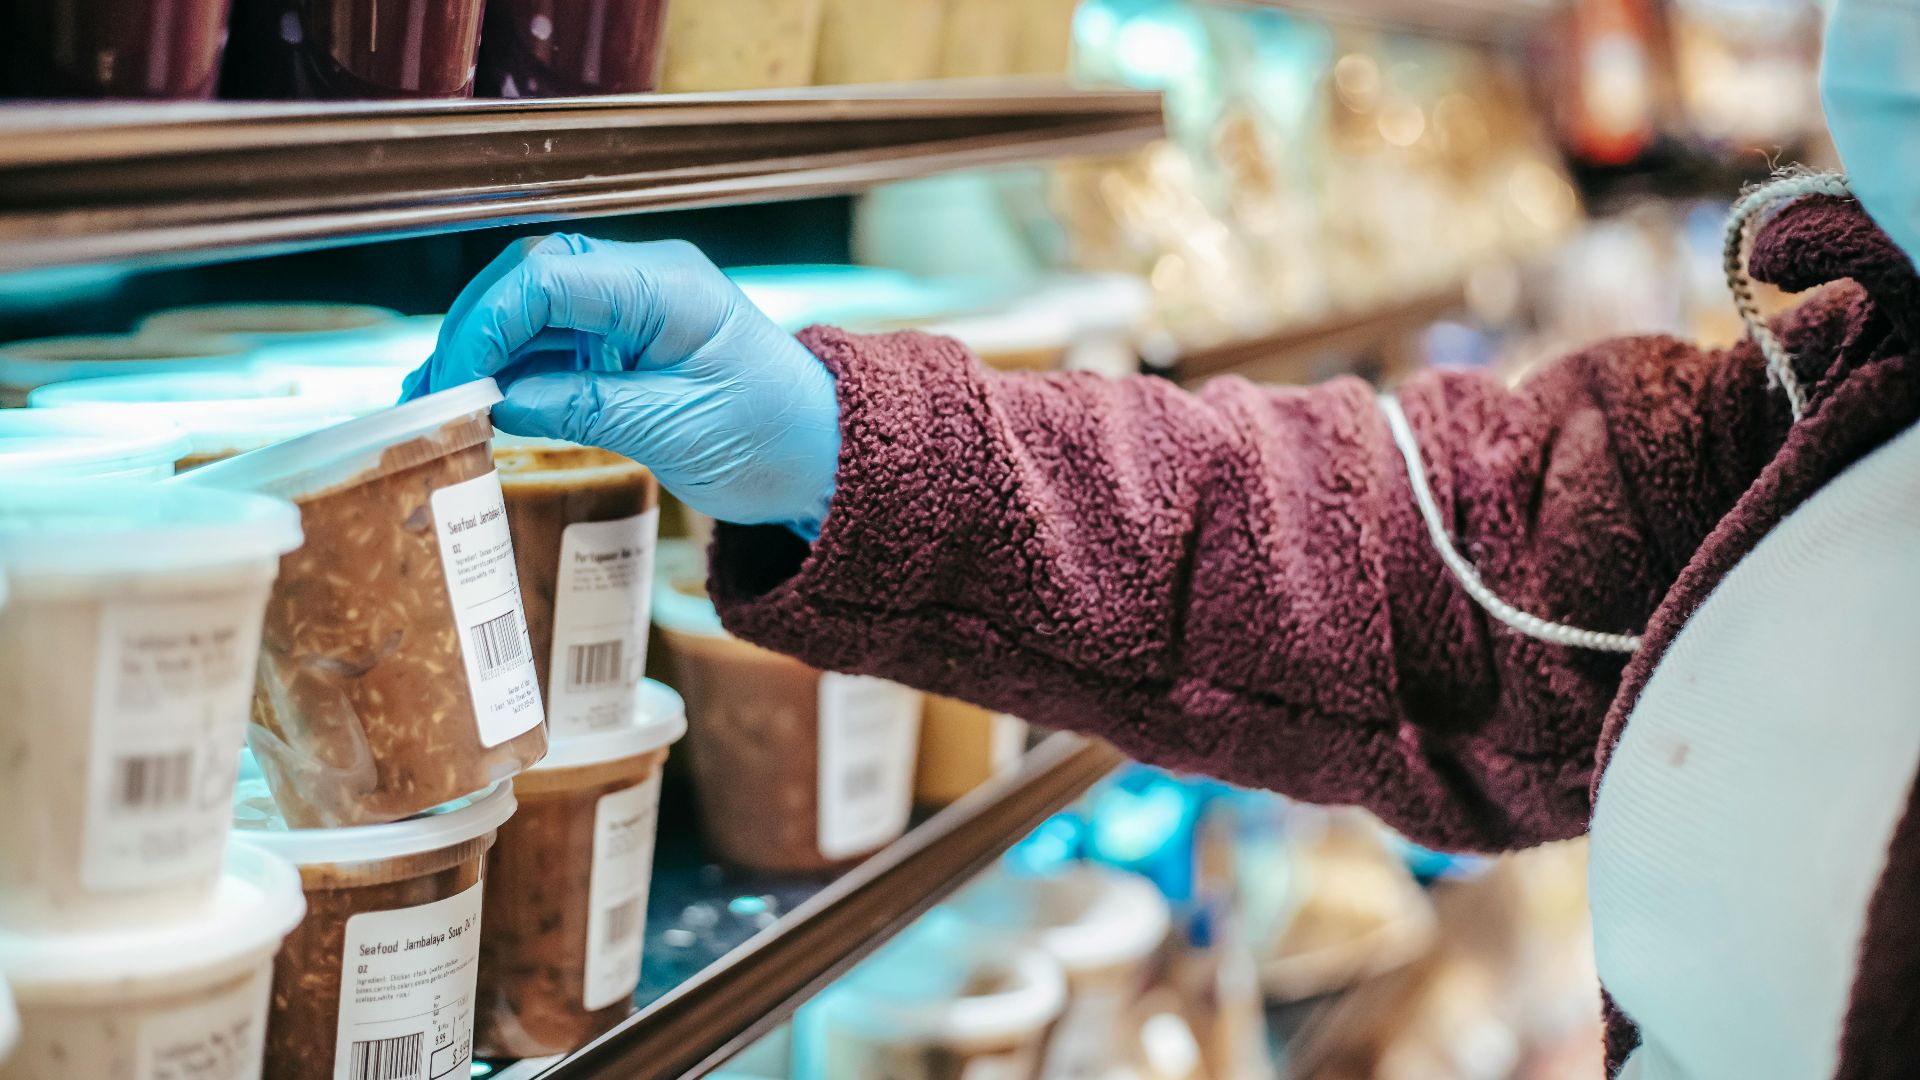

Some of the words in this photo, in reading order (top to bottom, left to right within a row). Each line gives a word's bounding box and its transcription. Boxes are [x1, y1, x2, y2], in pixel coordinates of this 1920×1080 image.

[448, 515, 477, 535] Seafood
[359, 941, 399, 957] Seafood
[403, 933, 445, 951] Jambalaya
[448, 925, 463, 939] Soup
